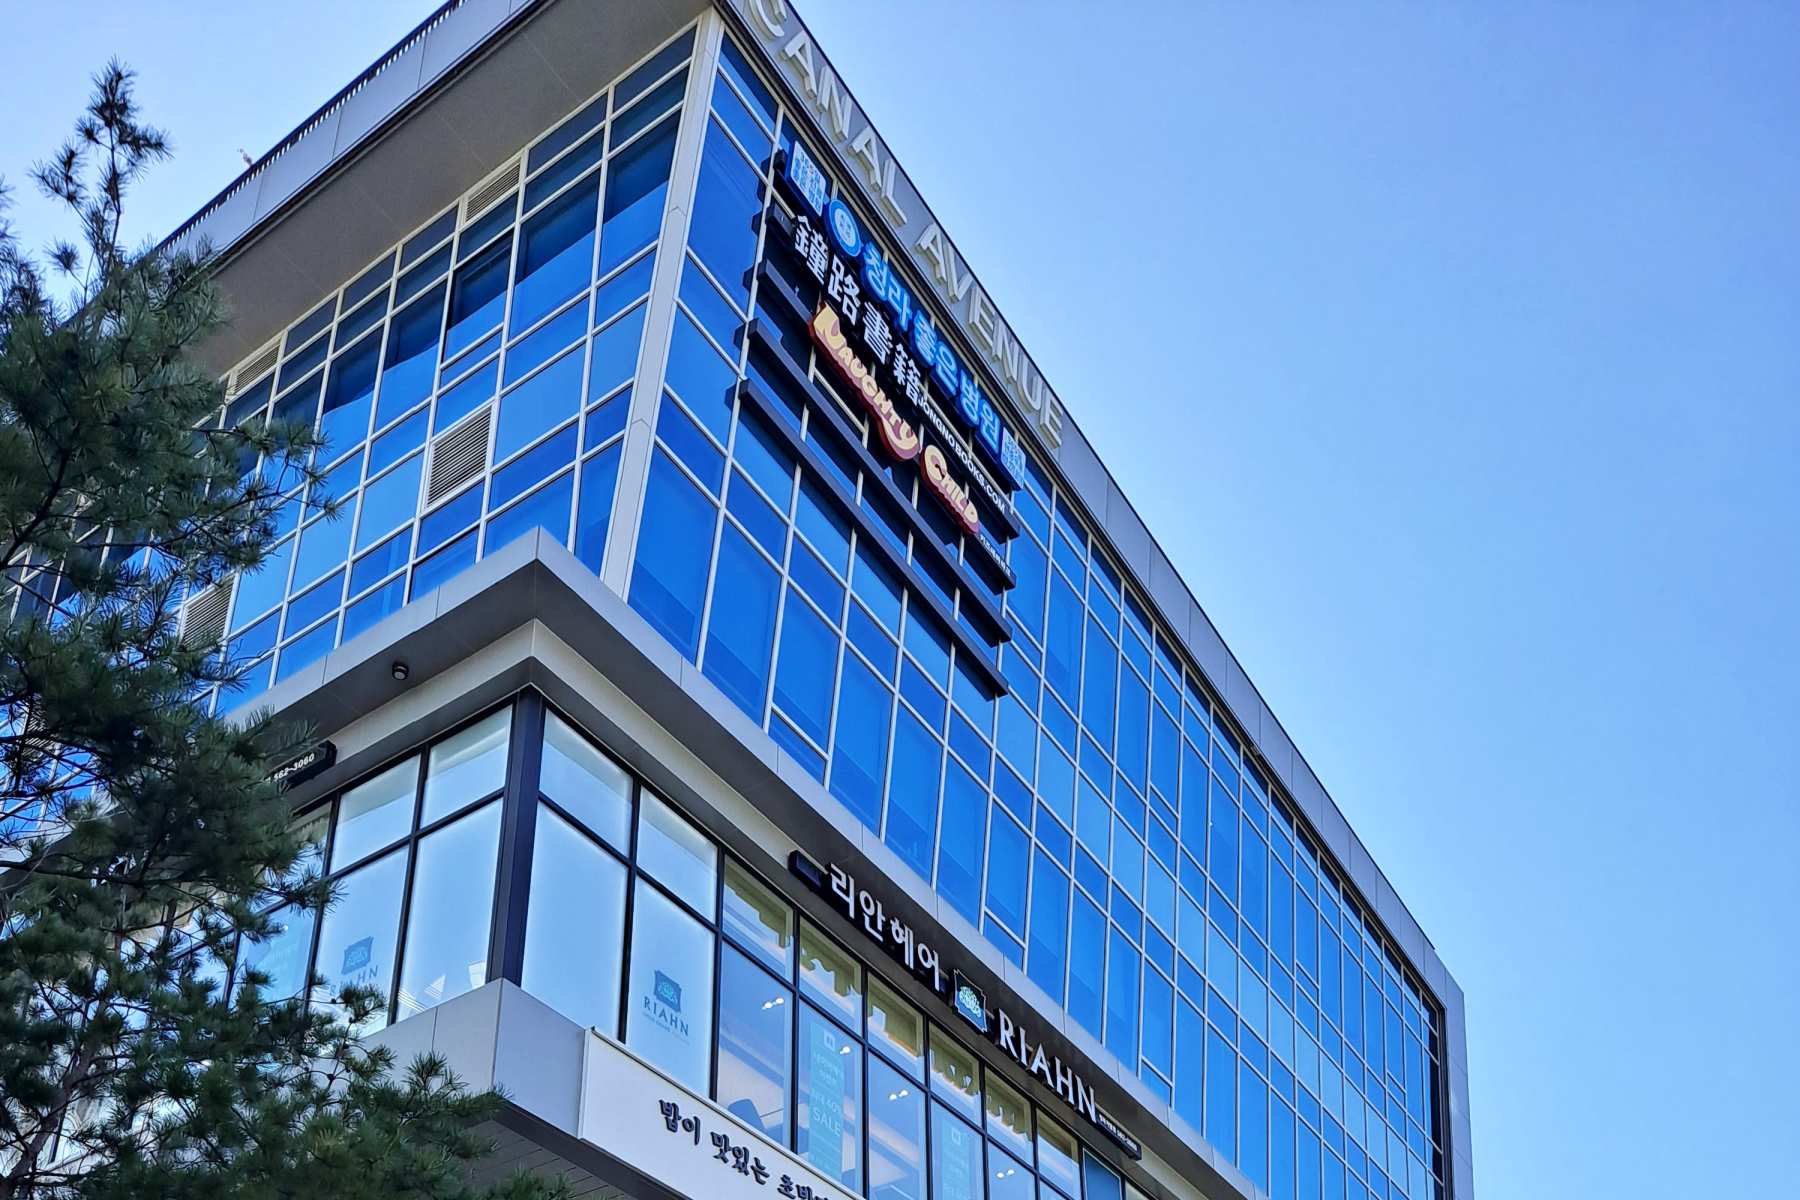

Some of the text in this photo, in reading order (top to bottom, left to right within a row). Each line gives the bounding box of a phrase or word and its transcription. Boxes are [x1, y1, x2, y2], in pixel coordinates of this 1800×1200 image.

[748, 0, 1066, 446] CANAL AVENUE
[921, 443, 980, 533] CHILD
[329, 964, 379, 997] RHN
[643, 995, 689, 1037] RIAHN
[829, 862, 1098, 1124] 리안헤어 RIAHN
[658, 1098, 701, 1146] 밥이
[709, 1129, 771, 1186] 맛있는
[812, 1107, 842, 1137] SALE
